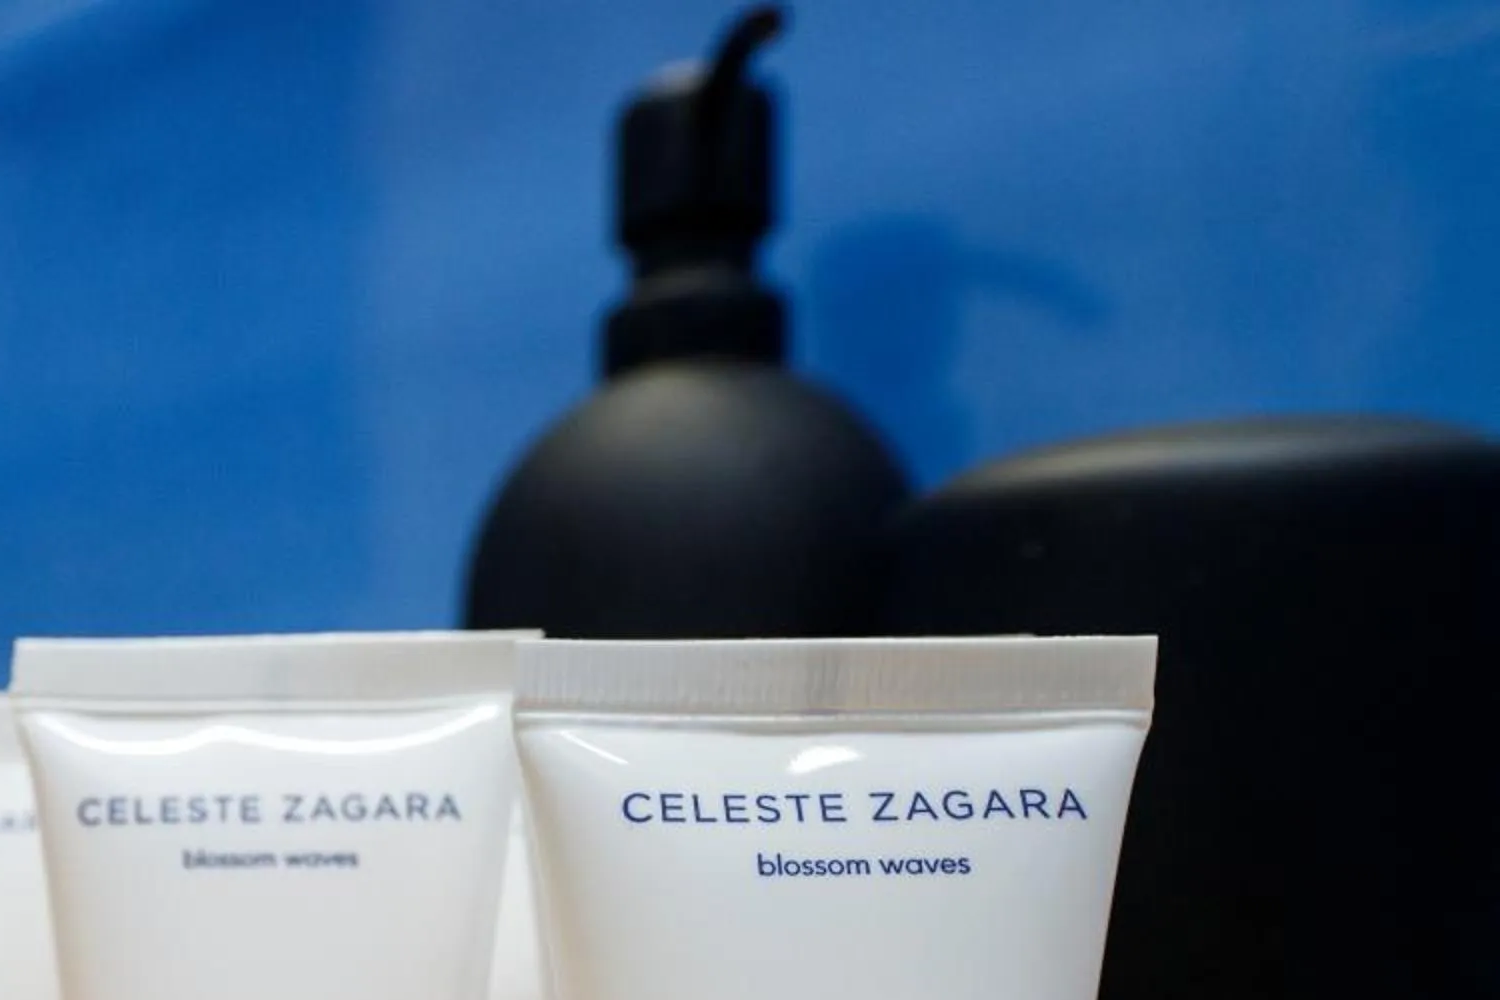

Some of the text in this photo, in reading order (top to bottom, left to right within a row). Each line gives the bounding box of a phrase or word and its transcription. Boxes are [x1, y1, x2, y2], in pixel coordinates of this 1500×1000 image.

[76, 792, 463, 828] CELESTE ZAGARA
[621, 788, 1088, 824] CELESTE ZAGARA
[756, 852, 973, 878] blossom waves
